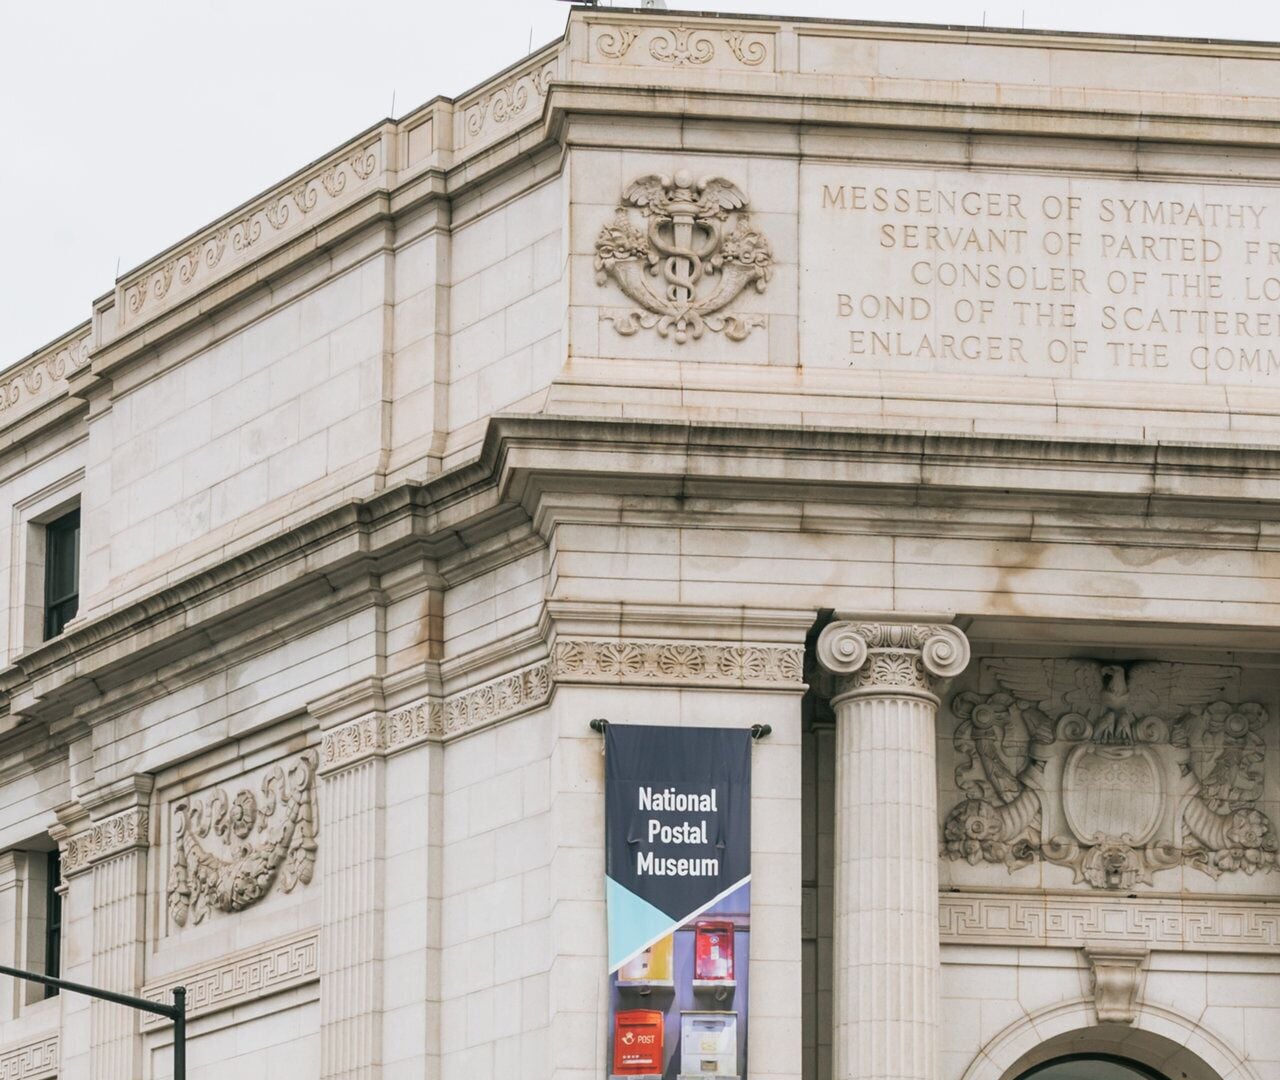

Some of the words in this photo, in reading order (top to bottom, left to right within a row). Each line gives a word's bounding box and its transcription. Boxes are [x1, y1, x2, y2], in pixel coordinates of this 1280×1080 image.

[821, 185, 1026, 219] MESSENGER
[1042, 194, 1082, 220] OF
[1099, 198, 1268, 230] SYMPATHY
[880, 223, 1028, 251] SERVANT
[1042, 231, 1082, 256] OF
[1100, 234, 1222, 264] PARTED
[910, 261, 1090, 295] CONSOLER
[1107, 270, 1148, 296] OF
[1161, 272, 1223, 299] THE
[836, 294, 931, 321] BOND
[954, 299, 995, 324] OF
[1012, 302, 1076, 328] THE
[848, 330, 1029, 364] ENLARGER
[1047, 339, 1089, 365] OF
[1106, 342, 1170, 368] THE
[638, 786, 718, 812] National
[648, 819, 708, 844] Postal
[636, 852, 719, 876] Museum
[637, 1035, 655, 1044] POST
